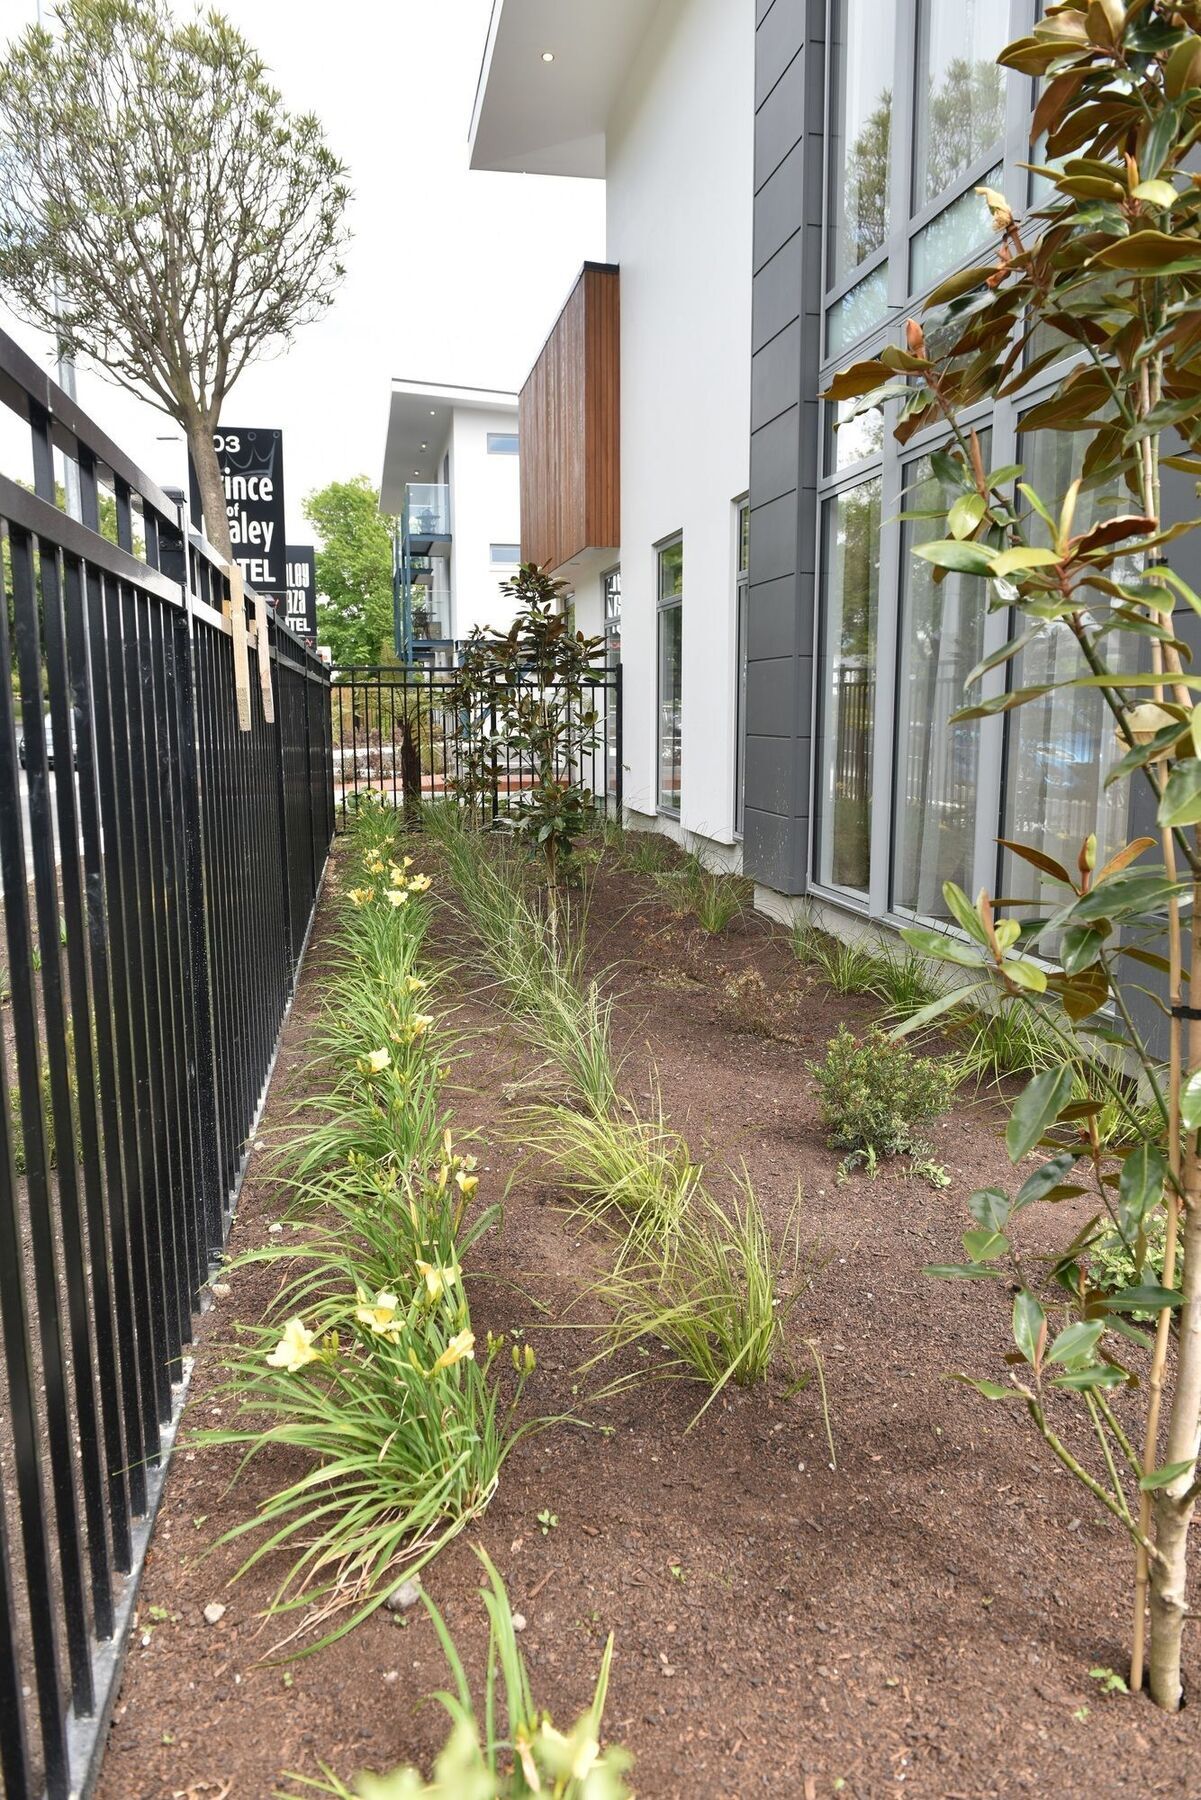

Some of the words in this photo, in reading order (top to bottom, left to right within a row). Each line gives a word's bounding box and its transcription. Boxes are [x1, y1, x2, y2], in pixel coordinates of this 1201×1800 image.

[213, 434, 240, 453] 03
[221, 466, 273, 502] ince
[226, 502, 240, 517] of
[232, 558, 276, 582] TEL
[285, 617, 311, 632] TEL
